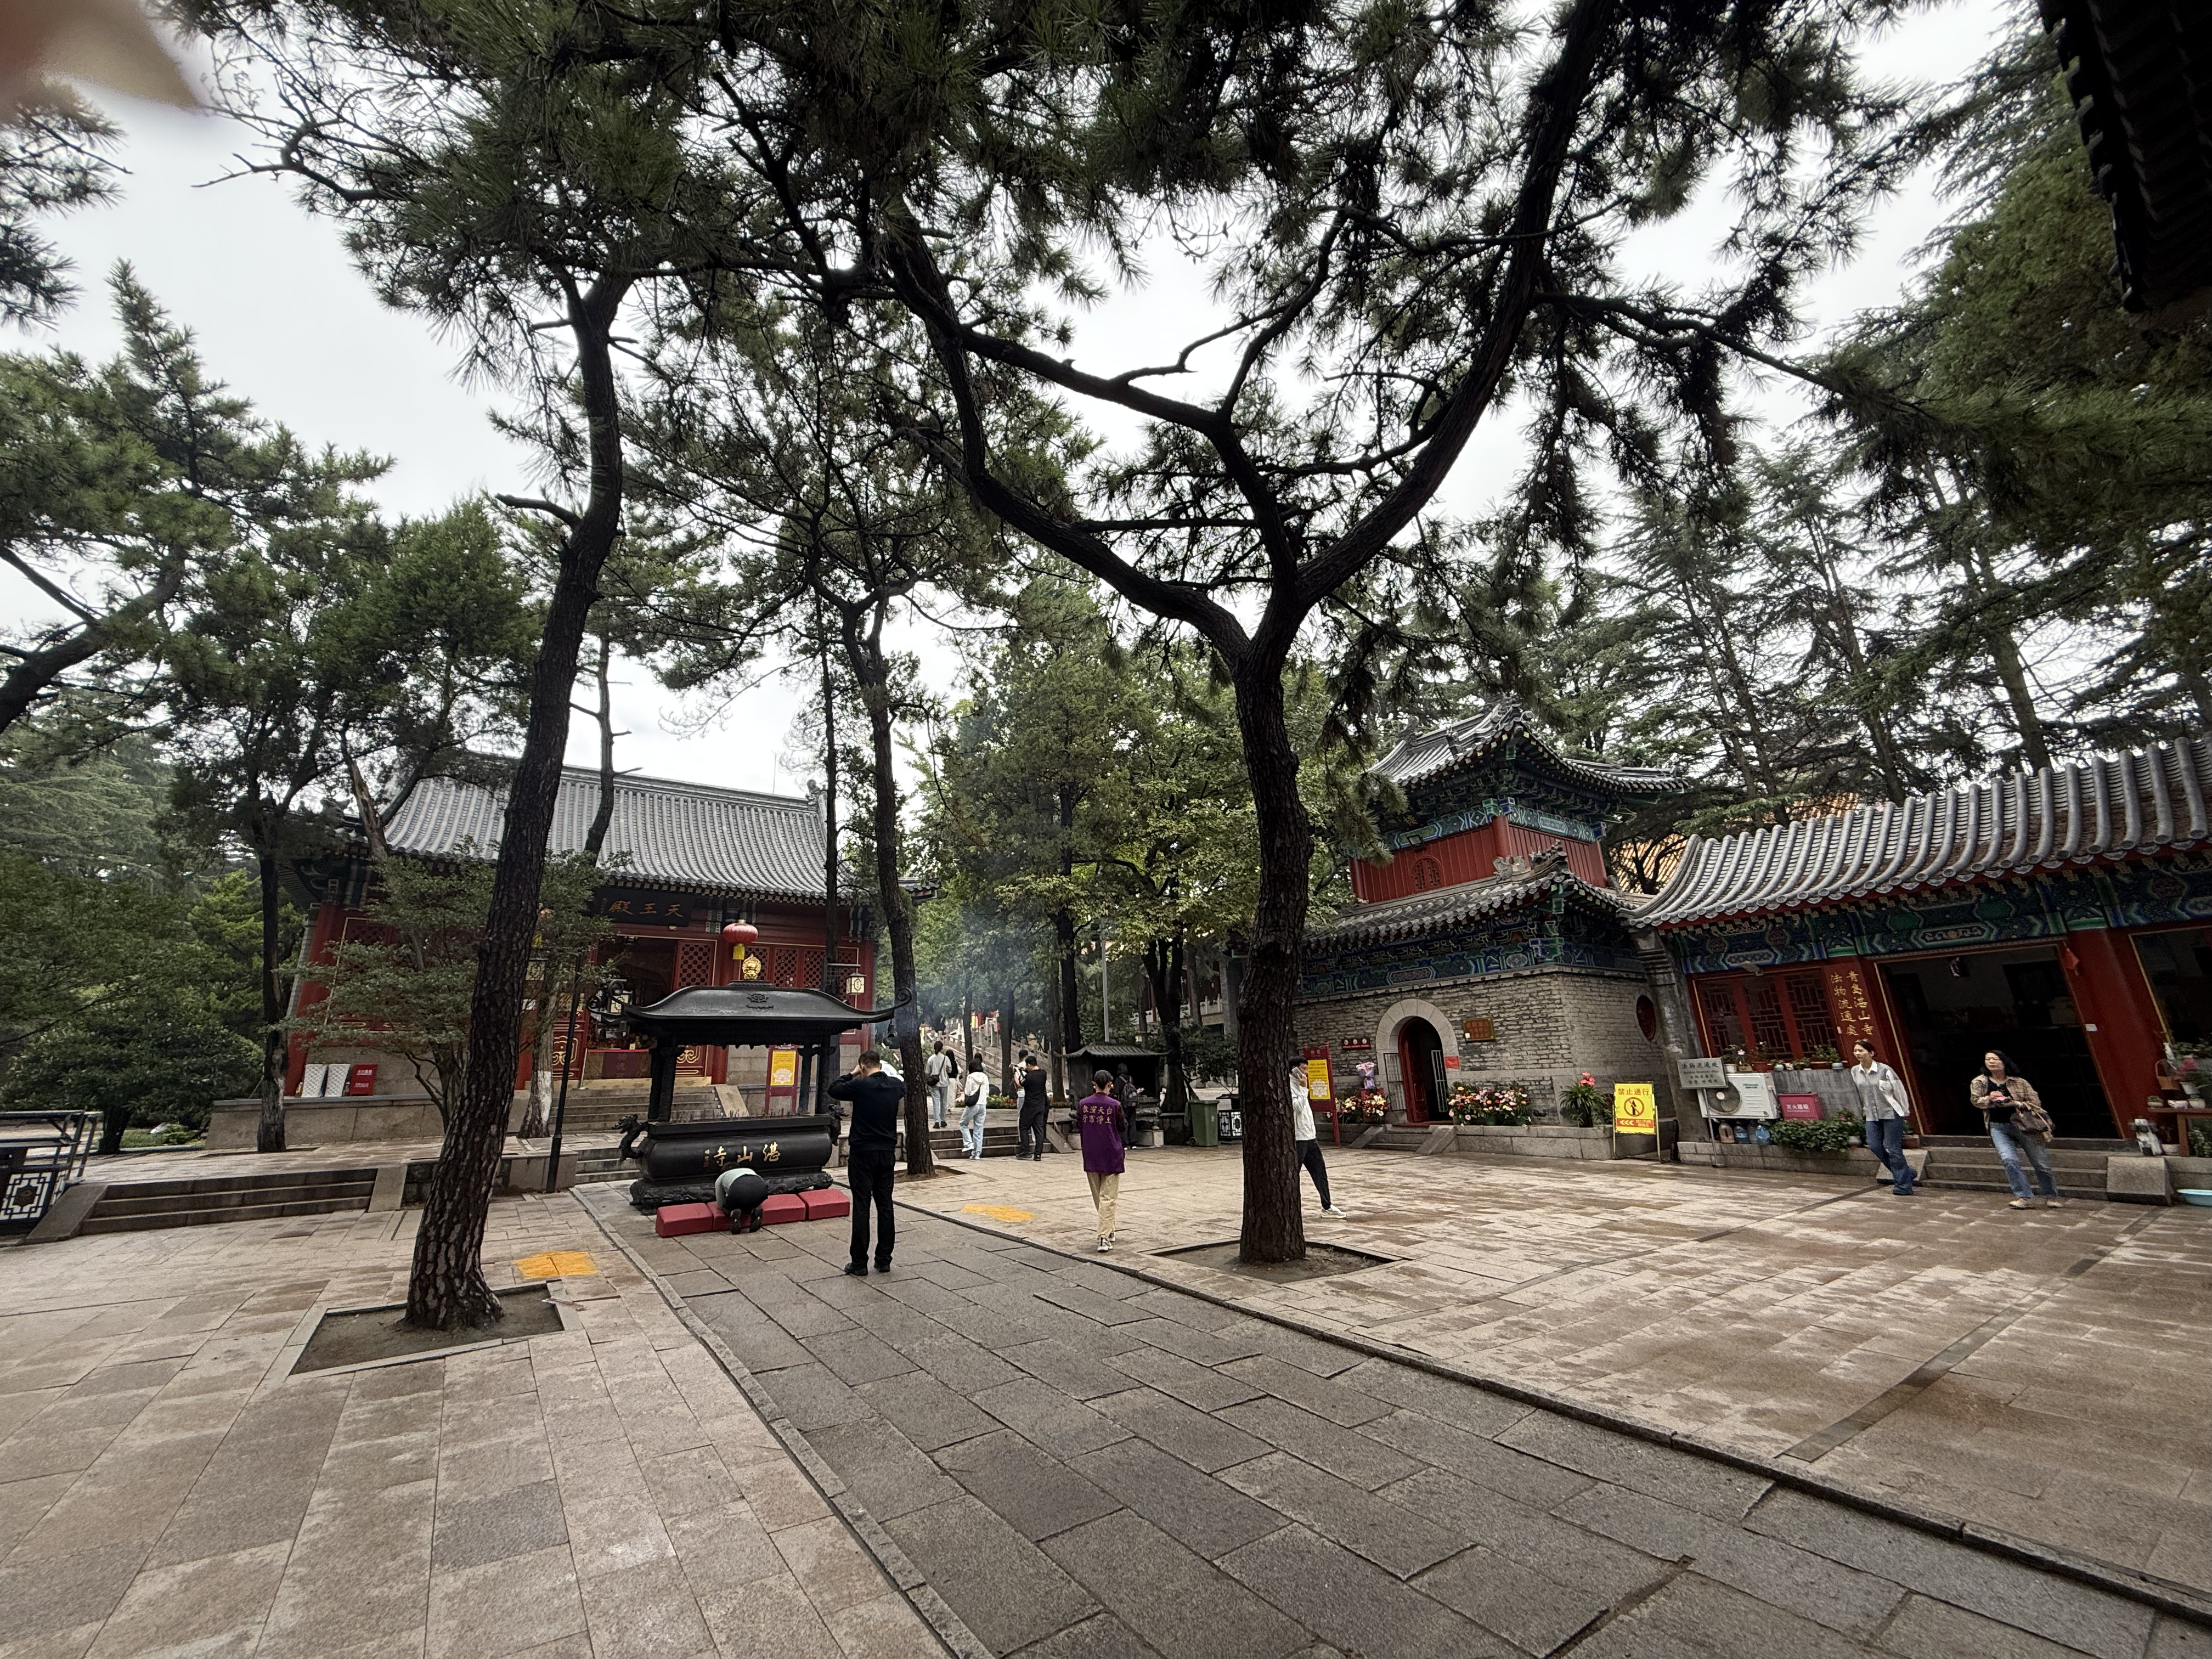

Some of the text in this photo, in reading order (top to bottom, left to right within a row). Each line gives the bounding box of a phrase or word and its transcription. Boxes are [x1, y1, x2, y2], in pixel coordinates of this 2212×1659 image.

[608, 900, 684, 917] 天王殿
[1831, 972, 1859, 1036] 法物流通處
[1846, 970, 1874, 1035] 青島湛山寺
[713, 1141, 781, 1166] 湛山寺
